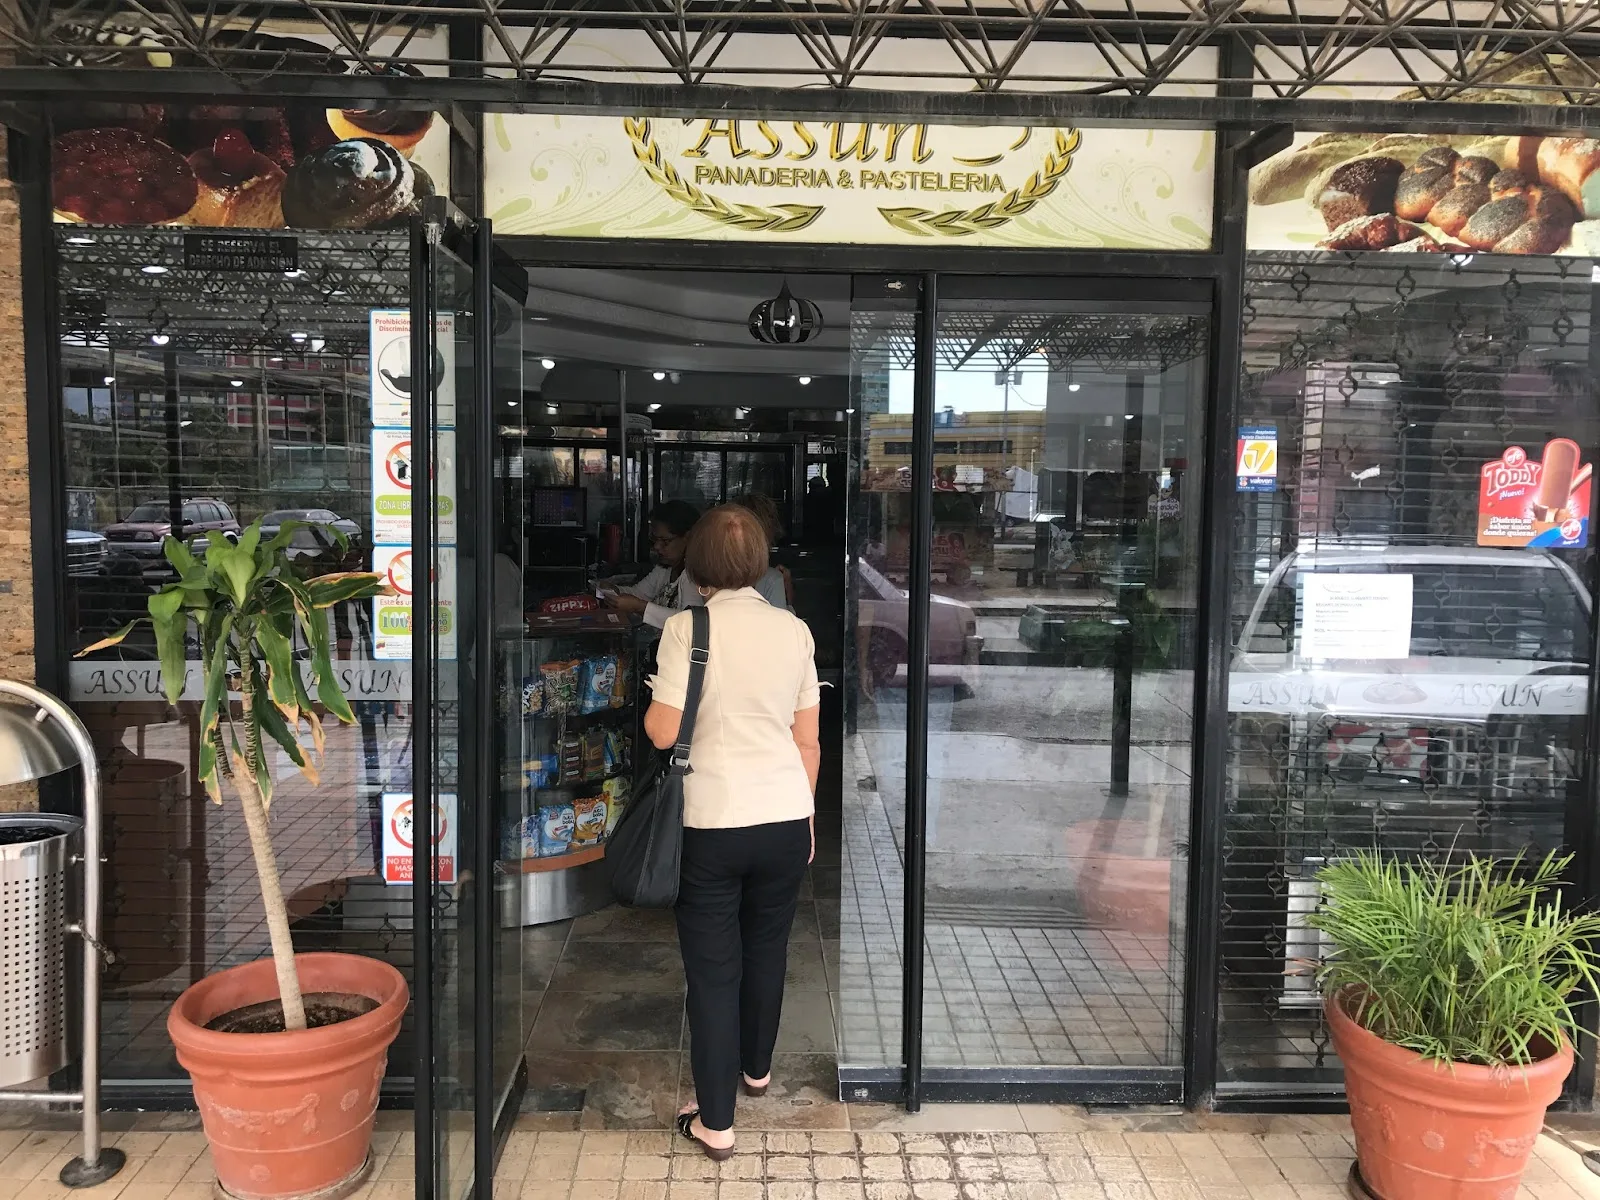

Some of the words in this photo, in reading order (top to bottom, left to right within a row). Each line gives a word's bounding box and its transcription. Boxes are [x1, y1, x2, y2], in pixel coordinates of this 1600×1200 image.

[694, 165, 833, 188] PANADERIA
[837, 170, 855, 189] &
[858, 169, 1007, 194] PASTELERIA
[200, 239, 214, 252] SE
[217, 240, 267, 253] RESERVA
[379, 500, 396, 510] ZONA
[397, 501, 412, 510] LIBR
[549, 599, 586, 612] ZIPPY
[1242, 681, 1341, 706] ASSUN
[1444, 682, 1549, 708] ASSUN
